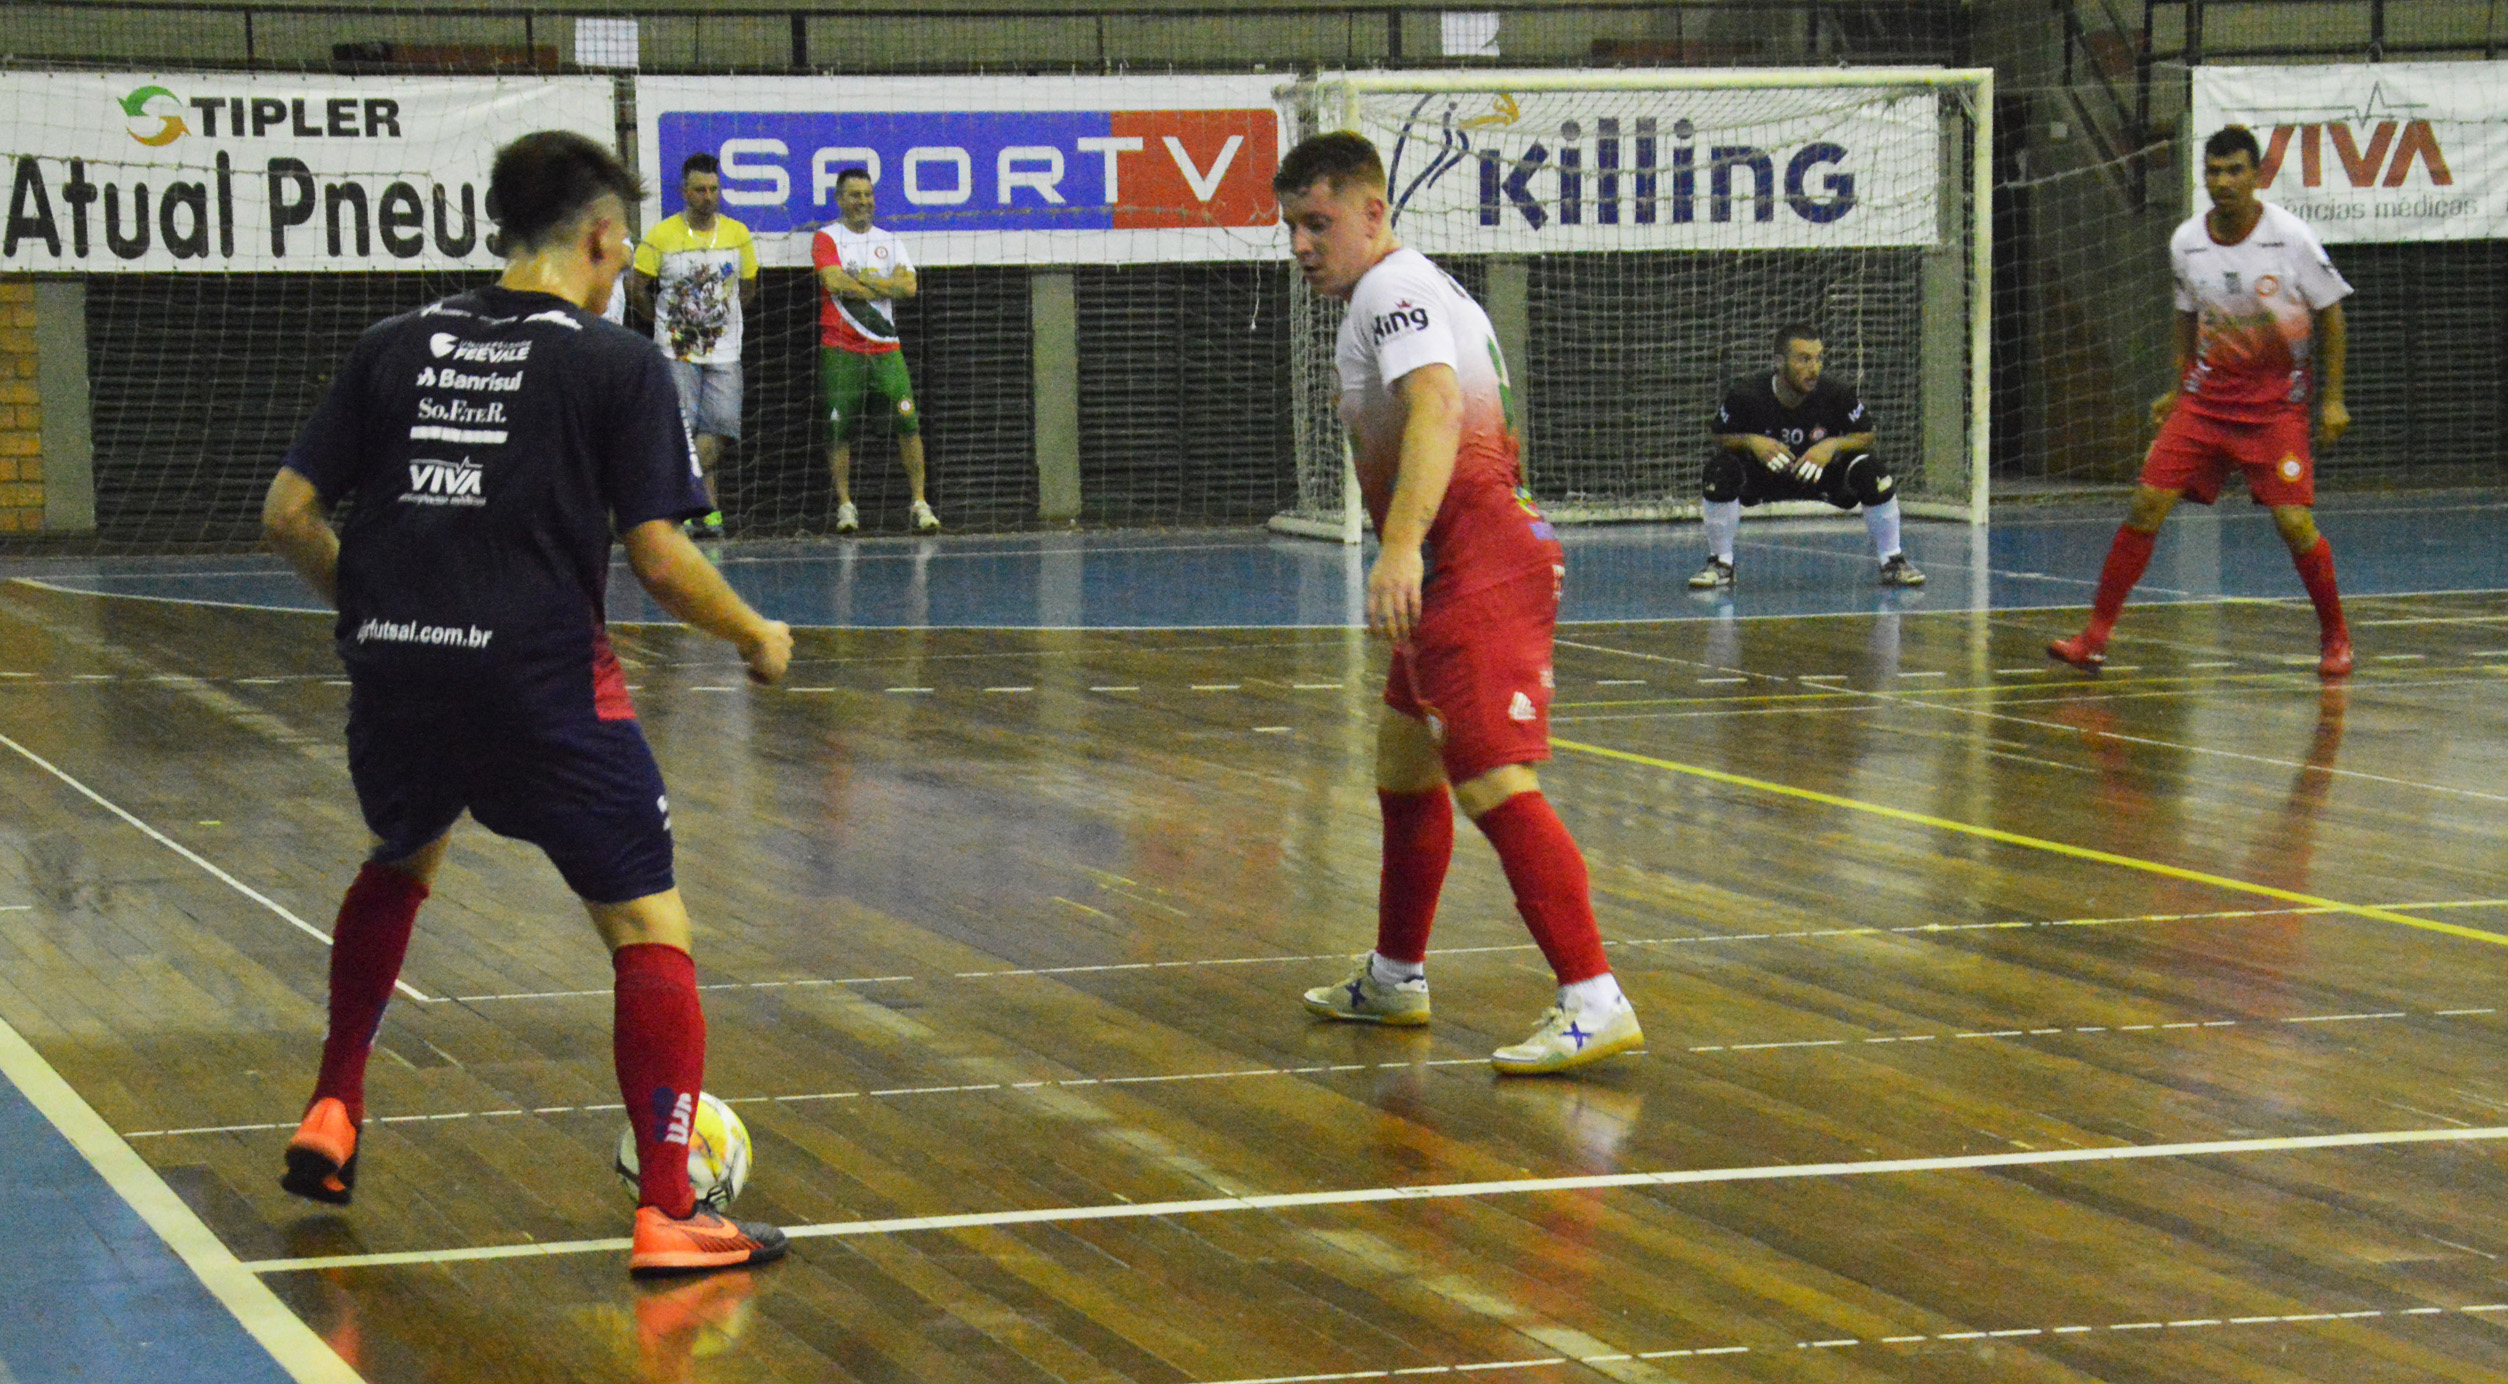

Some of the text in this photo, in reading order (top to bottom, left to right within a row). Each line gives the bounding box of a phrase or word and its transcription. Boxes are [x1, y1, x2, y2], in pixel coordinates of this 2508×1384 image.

[190, 97, 401, 137] TIPLER
[718, 135, 1244, 206] SPORTV
[2254, 120, 2454, 189] VIVA
[3, 150, 234, 258] Atual
[453, 346, 531, 363] FEEVALE
[438, 368, 523, 391] Banrisul
[1781, 428, 1804, 444] 30
[409, 464, 482, 496] VIVA
